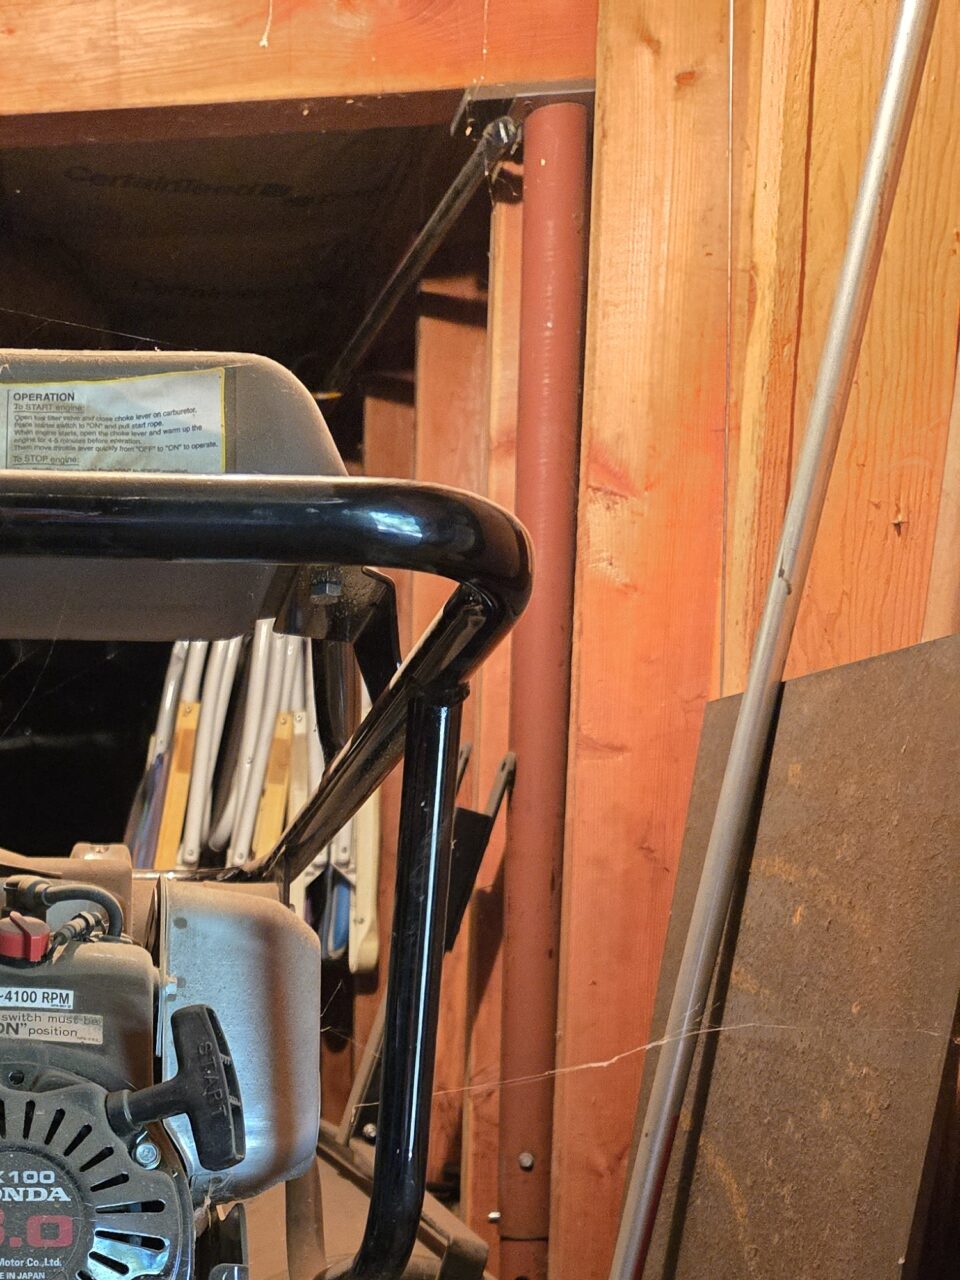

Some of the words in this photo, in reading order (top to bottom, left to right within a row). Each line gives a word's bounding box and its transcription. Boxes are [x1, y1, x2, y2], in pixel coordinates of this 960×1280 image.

[13, 392, 75, 402] OPERATION
[13, 403, 23, 411] To
[25, 403, 53, 411] START
[136, 412, 151, 420] lever
[162, 407, 197, 418] carburetor.
[147, 420, 164, 428] rope.
[182, 426, 191, 434] up
[191, 424, 202, 432] the
[191, 441, 218, 451] operate.
[13, 455, 23, 463] To
[24, 455, 48, 463] STOP
[41, 991, 70, 1005] RPM
[1, 1013, 41, 1023] switch
[47, 1014, 79, 1025] must
[28, 1026, 78, 1038] position
[198, 1041, 227, 1117] START
[6, 1271, 15, 1280] IN
[16, 1271, 46, 1280] JAPAN
